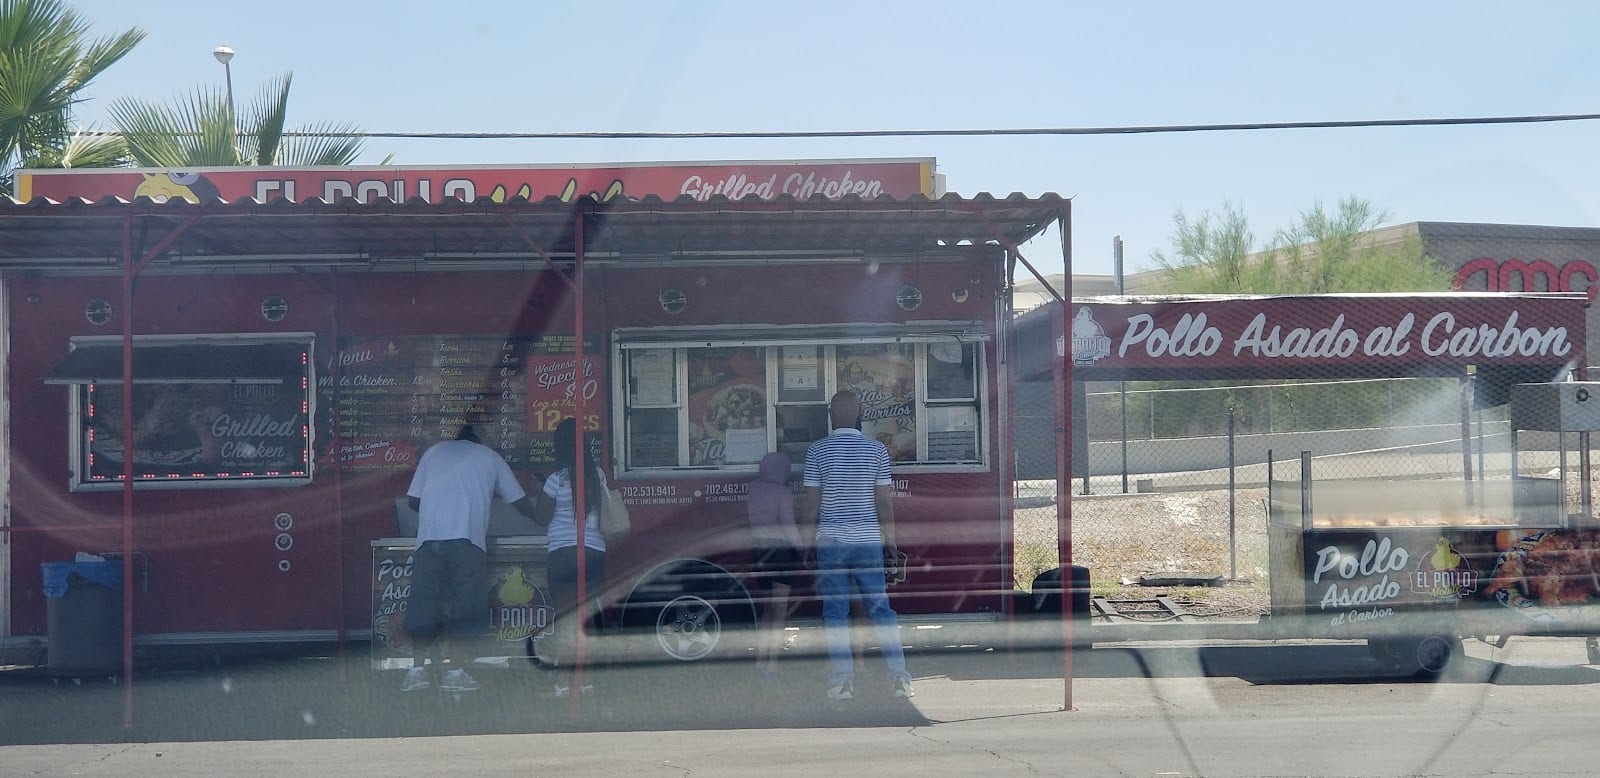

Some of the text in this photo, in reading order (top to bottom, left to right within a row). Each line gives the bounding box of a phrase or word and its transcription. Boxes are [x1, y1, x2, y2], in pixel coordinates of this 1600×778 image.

[681, 170, 884, 202] Grilled Chicken
[1118, 312, 1224, 359] Pollo
[1234, 312, 1360, 358] Asado
[1363, 312, 1415, 357] al
[1421, 310, 1572, 357] Carbon
[319, 375, 350, 386] Whle
[537, 363, 593, 389] Specil
[565, 380, 598, 400] $0
[212, 413, 298, 437] Grilled
[622, 486, 677, 497] 702.531.9413
[704, 482, 749, 495] 702.462.17
[378, 556, 414, 582] Pol
[1314, 536, 1410, 585] Pollo
[1417, 571, 1471, 588] EL POLLO
[1320, 574, 1401, 610] Asado
[384, 601, 398, 615] al
[502, 607, 548, 629] POLLO
[1331, 606, 1395, 626] al Carbon
